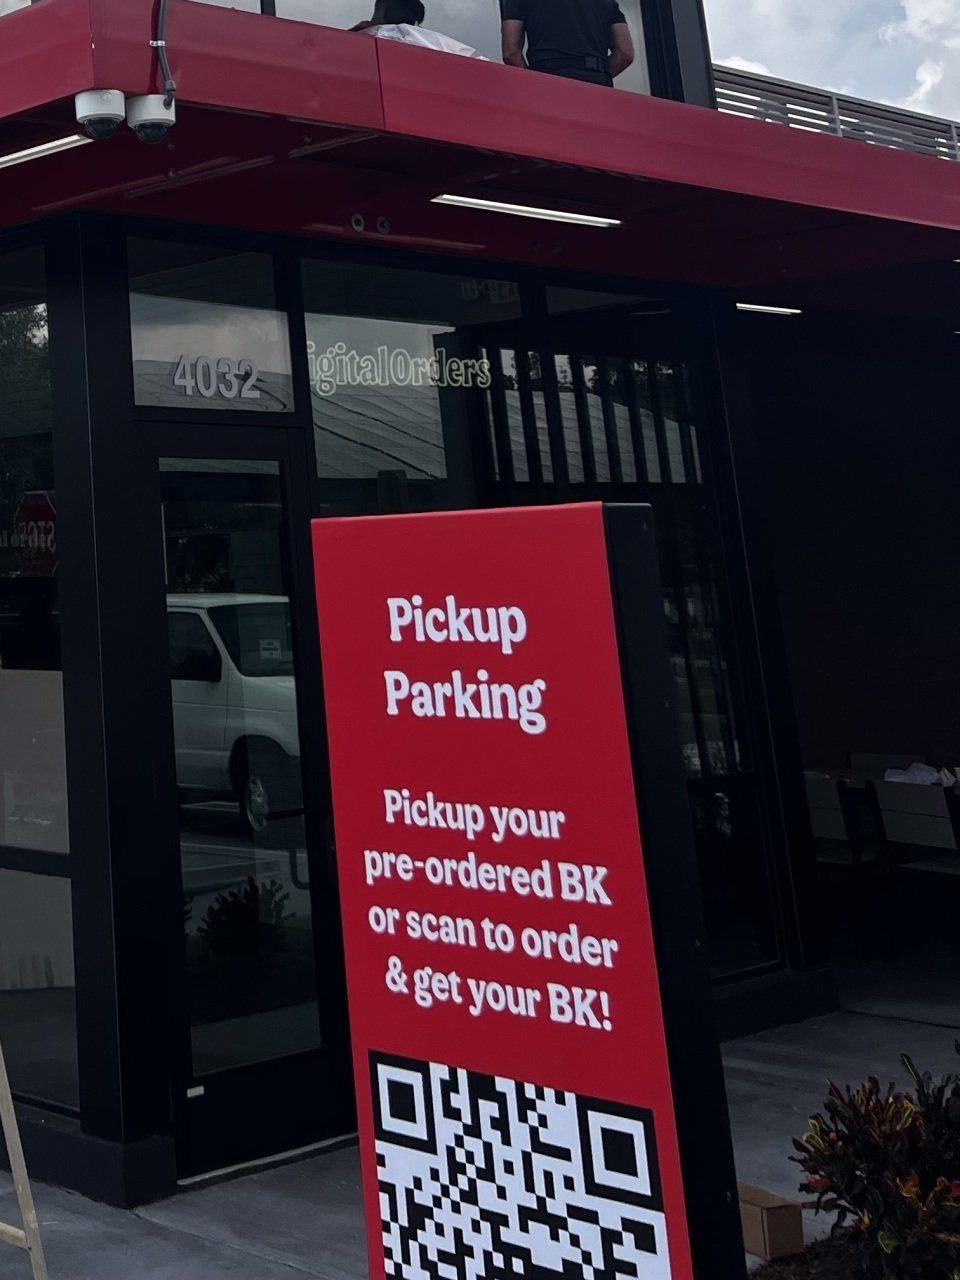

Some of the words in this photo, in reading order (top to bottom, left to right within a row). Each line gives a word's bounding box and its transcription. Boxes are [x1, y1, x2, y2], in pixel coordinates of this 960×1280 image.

[172, 353, 262, 400] 4032
[386, 594, 527, 655] Pickup
[383, 669, 547, 734] Parking
[384, 788, 485, 841] Pickup
[490, 806, 566, 843] your
[363, 849, 553, 899] pre-ordered
[557, 862, 613, 906] BK
[368, 905, 400, 935] or
[405, 910, 476, 948] scan
[480, 917, 515, 953] to
[520, 923, 619, 968] order
[385, 955, 409, 994] &
[413, 966, 463, 1008] get
[467, 978, 542, 1018] your
[546, 982, 613, 1032] BK!
